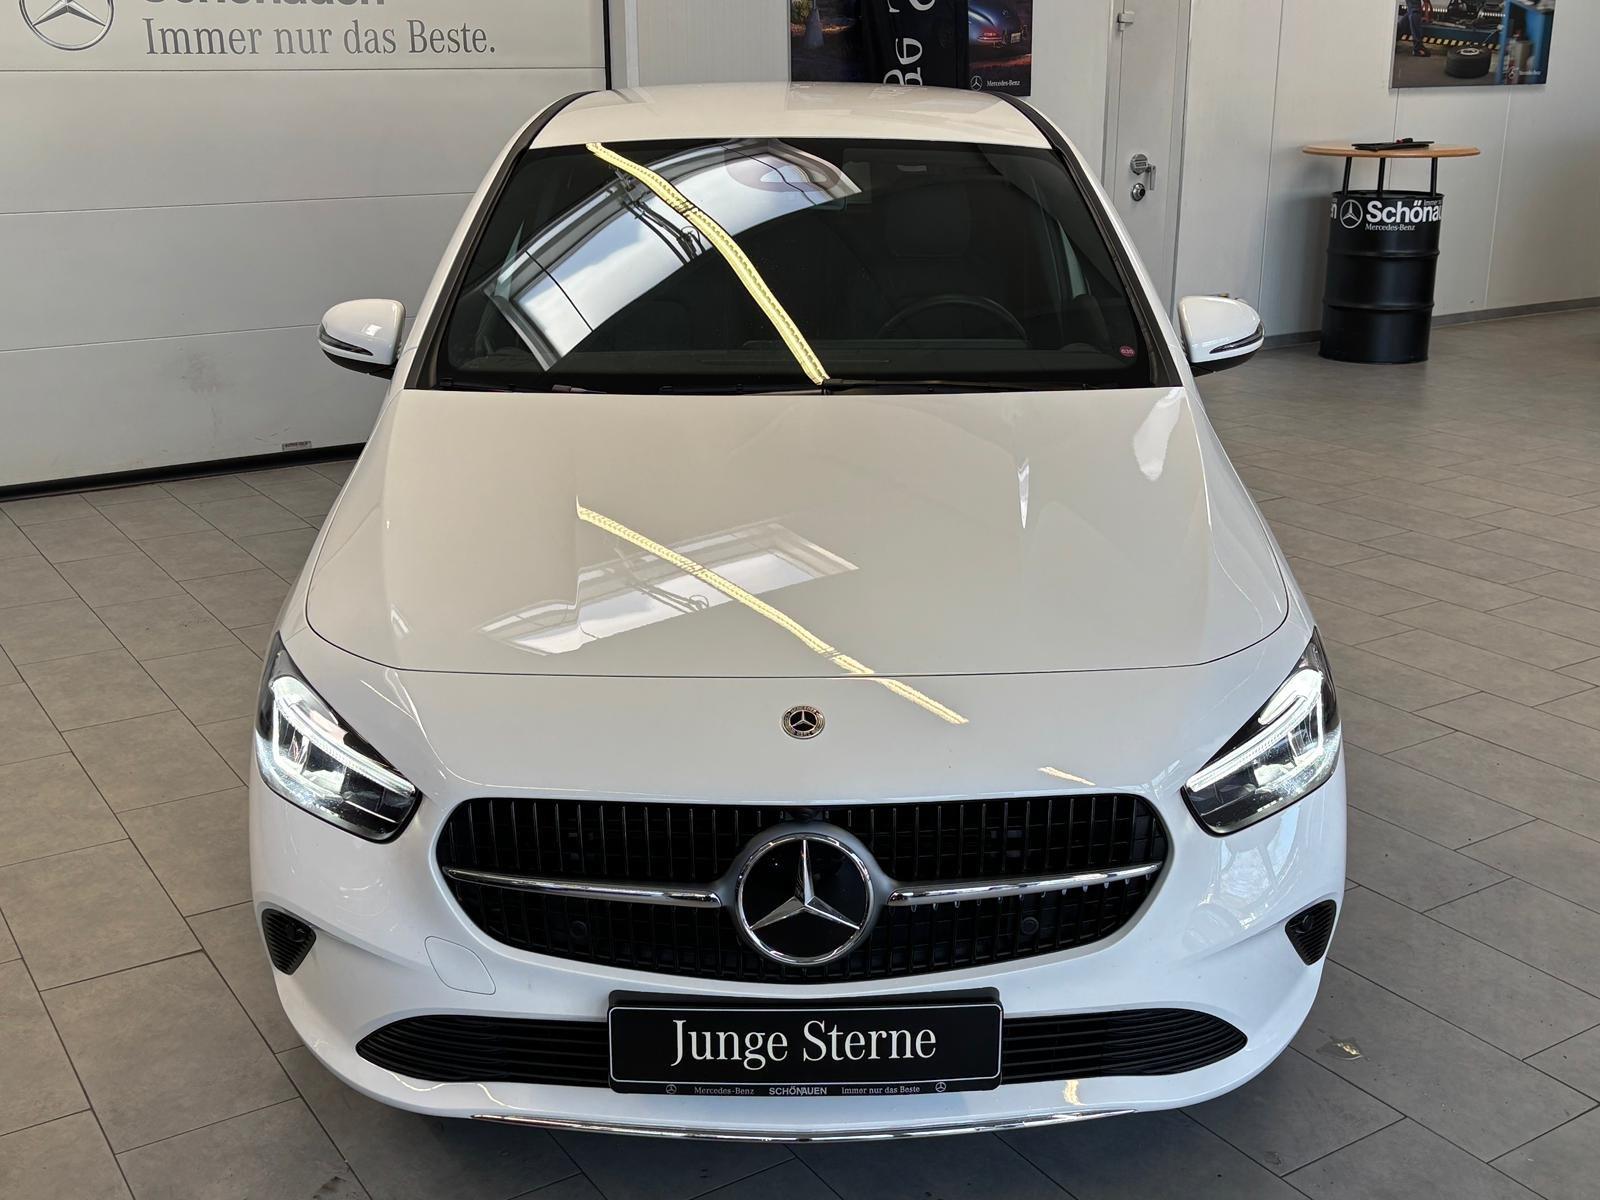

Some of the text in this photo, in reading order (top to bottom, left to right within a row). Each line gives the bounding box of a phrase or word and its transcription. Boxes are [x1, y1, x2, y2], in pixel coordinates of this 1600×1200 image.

[142, 17, 497, 56] Immer nur das Beste.
[1365, 223, 1416, 231] Mercedes-Benz
[670, 1019, 937, 1071] Junge Sterne
[694, 1086, 755, 1095] Mercedes-Benz
[768, 1085, 828, 1096] SCHÖNAUEN
[841, 1086, 867, 1094] Immer
[884, 1086, 898, 1094] das
[899, 1085, 921, 1094] Beste
